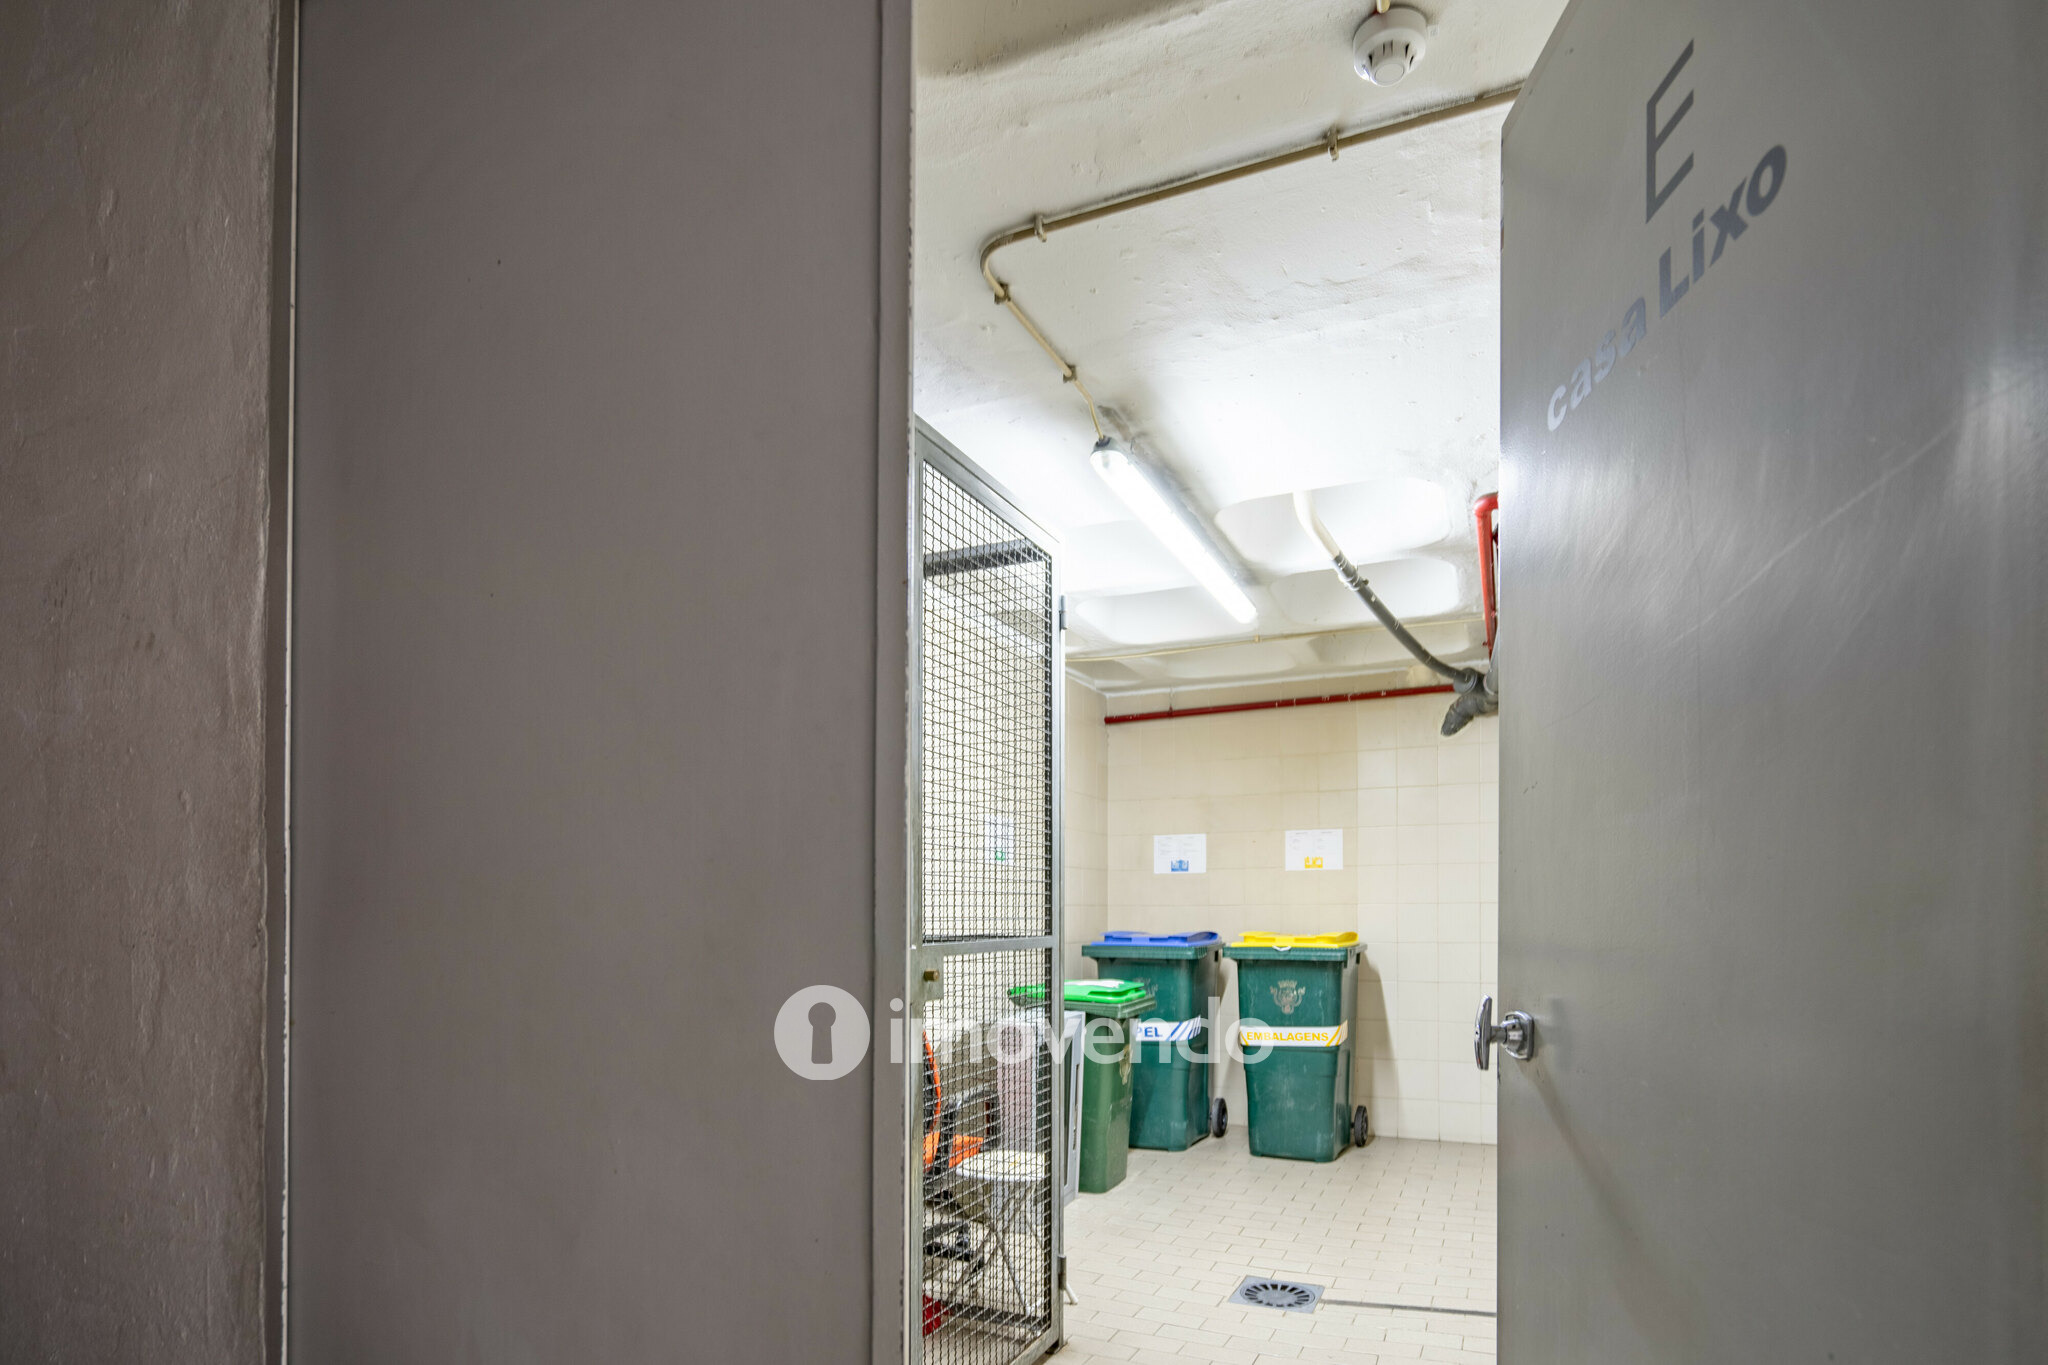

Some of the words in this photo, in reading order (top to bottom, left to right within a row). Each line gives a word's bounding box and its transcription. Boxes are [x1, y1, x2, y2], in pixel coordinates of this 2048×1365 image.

[1645, 38, 1694, 225] E
[1547, 297, 1648, 432] casa
[1659, 143, 1788, 320] Lixo
[1246, 1031, 1329, 1042] EMBALAGENS
